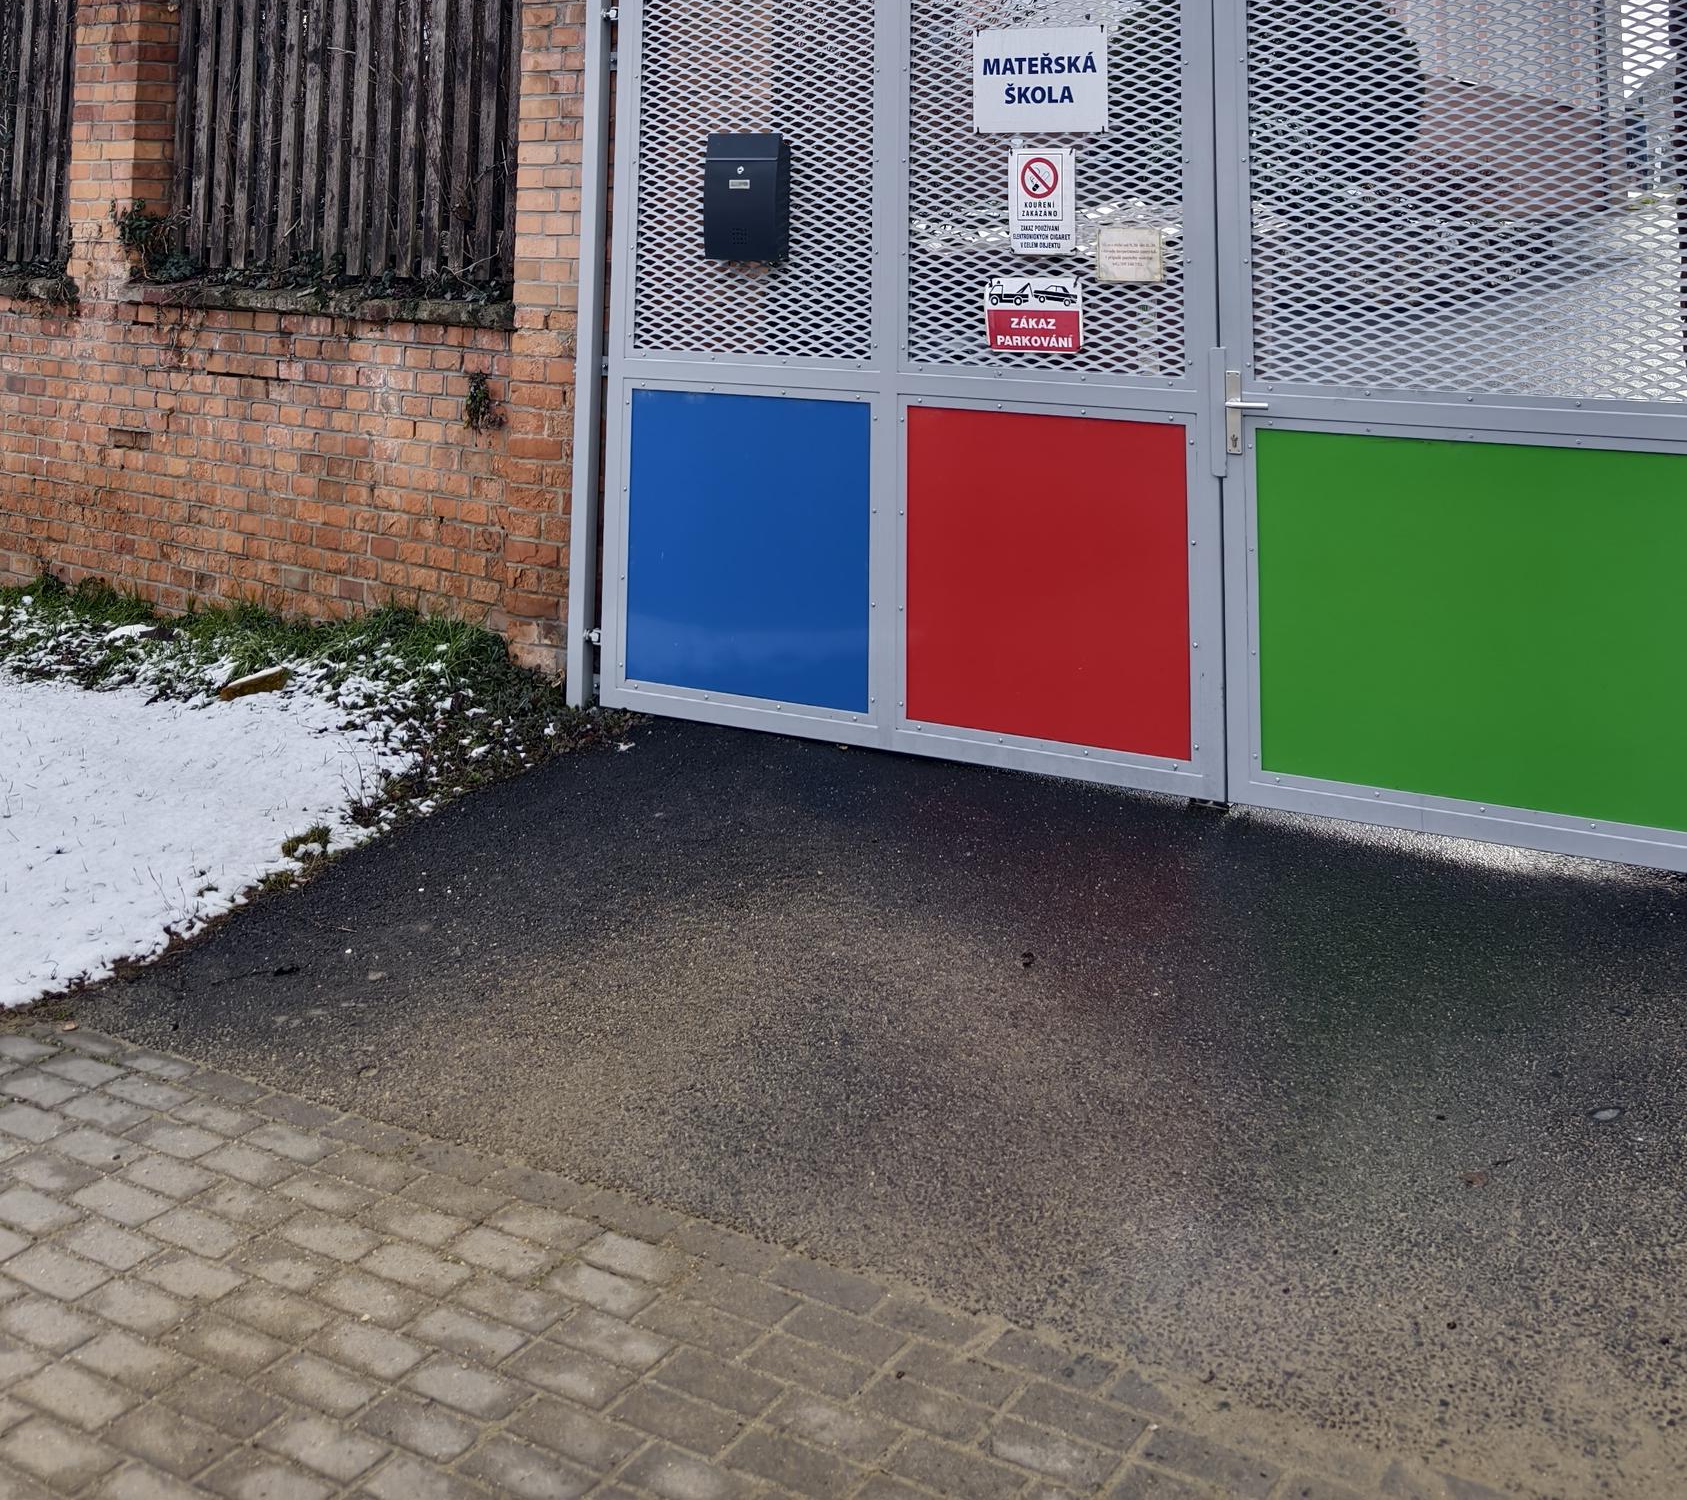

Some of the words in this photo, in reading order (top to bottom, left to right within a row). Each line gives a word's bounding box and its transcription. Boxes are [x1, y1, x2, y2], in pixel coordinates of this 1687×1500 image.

[982, 51, 1097, 76] MATEŘSKÁ
[1004, 83, 1074, 105] ŠKOLA
[1010, 316, 1057, 329] ZÁKAZ
[996, 335, 1073, 348] PARKOVÁNÍ
